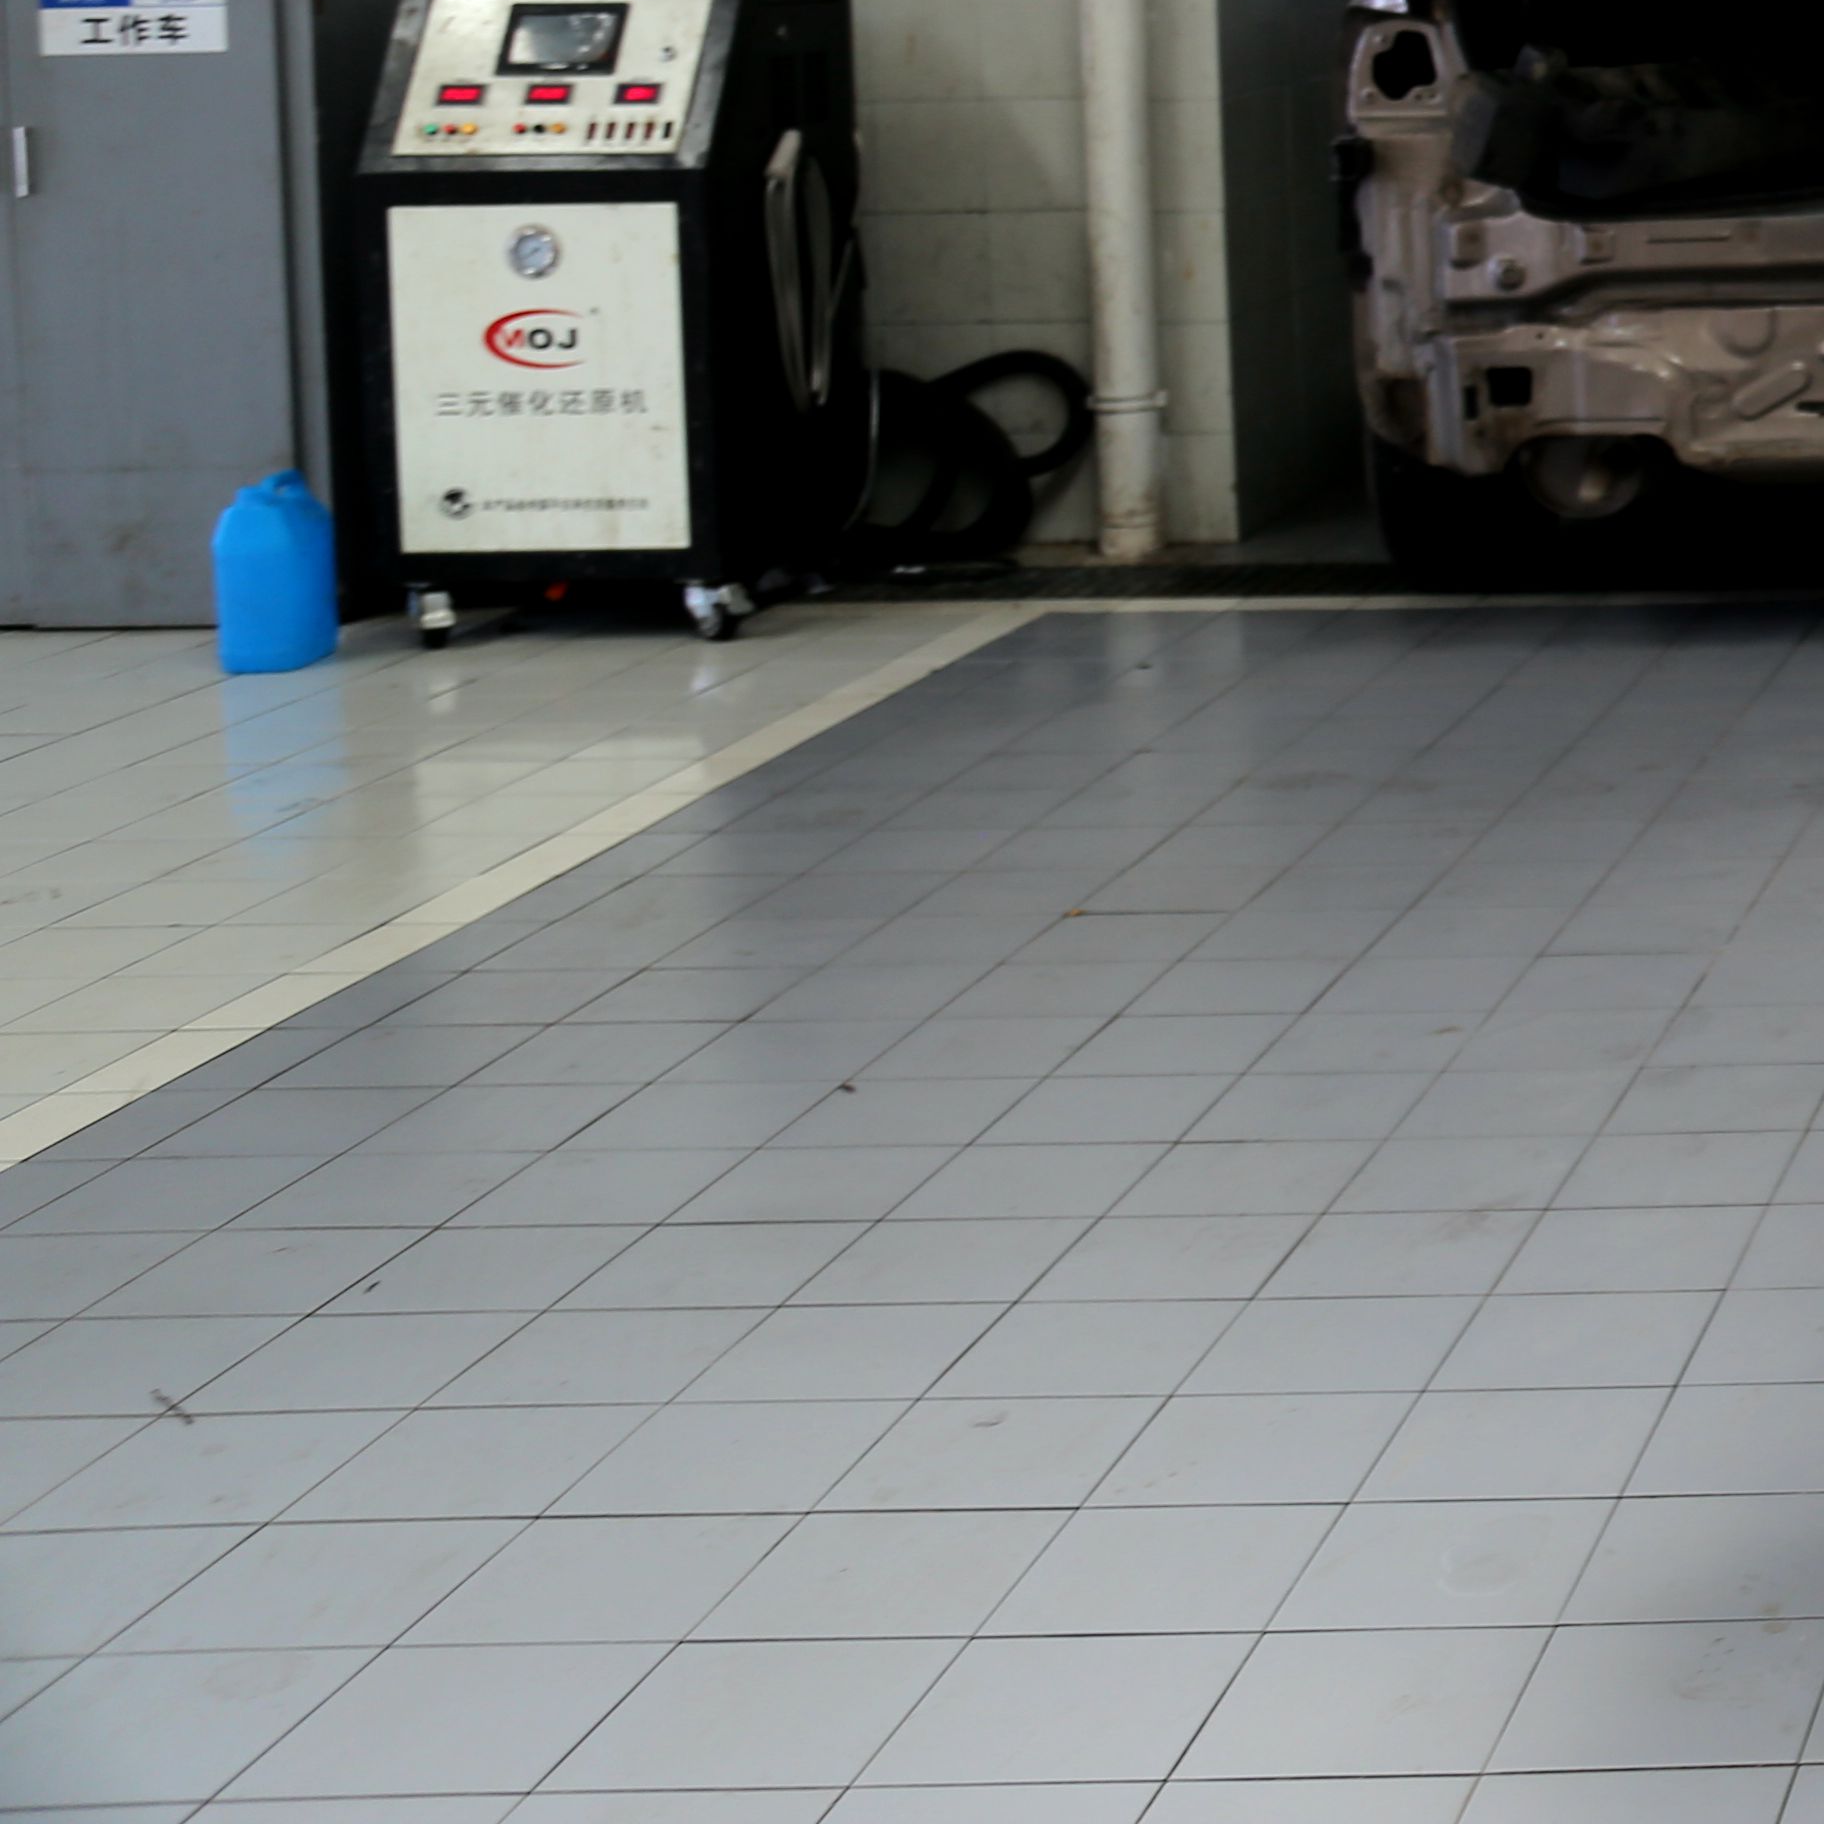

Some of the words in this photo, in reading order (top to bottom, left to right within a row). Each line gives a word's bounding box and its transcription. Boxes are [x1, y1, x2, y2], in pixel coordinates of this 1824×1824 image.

[80, 14, 190, 46] 工作车
[434, 388, 649, 417] 三元催化还原机
